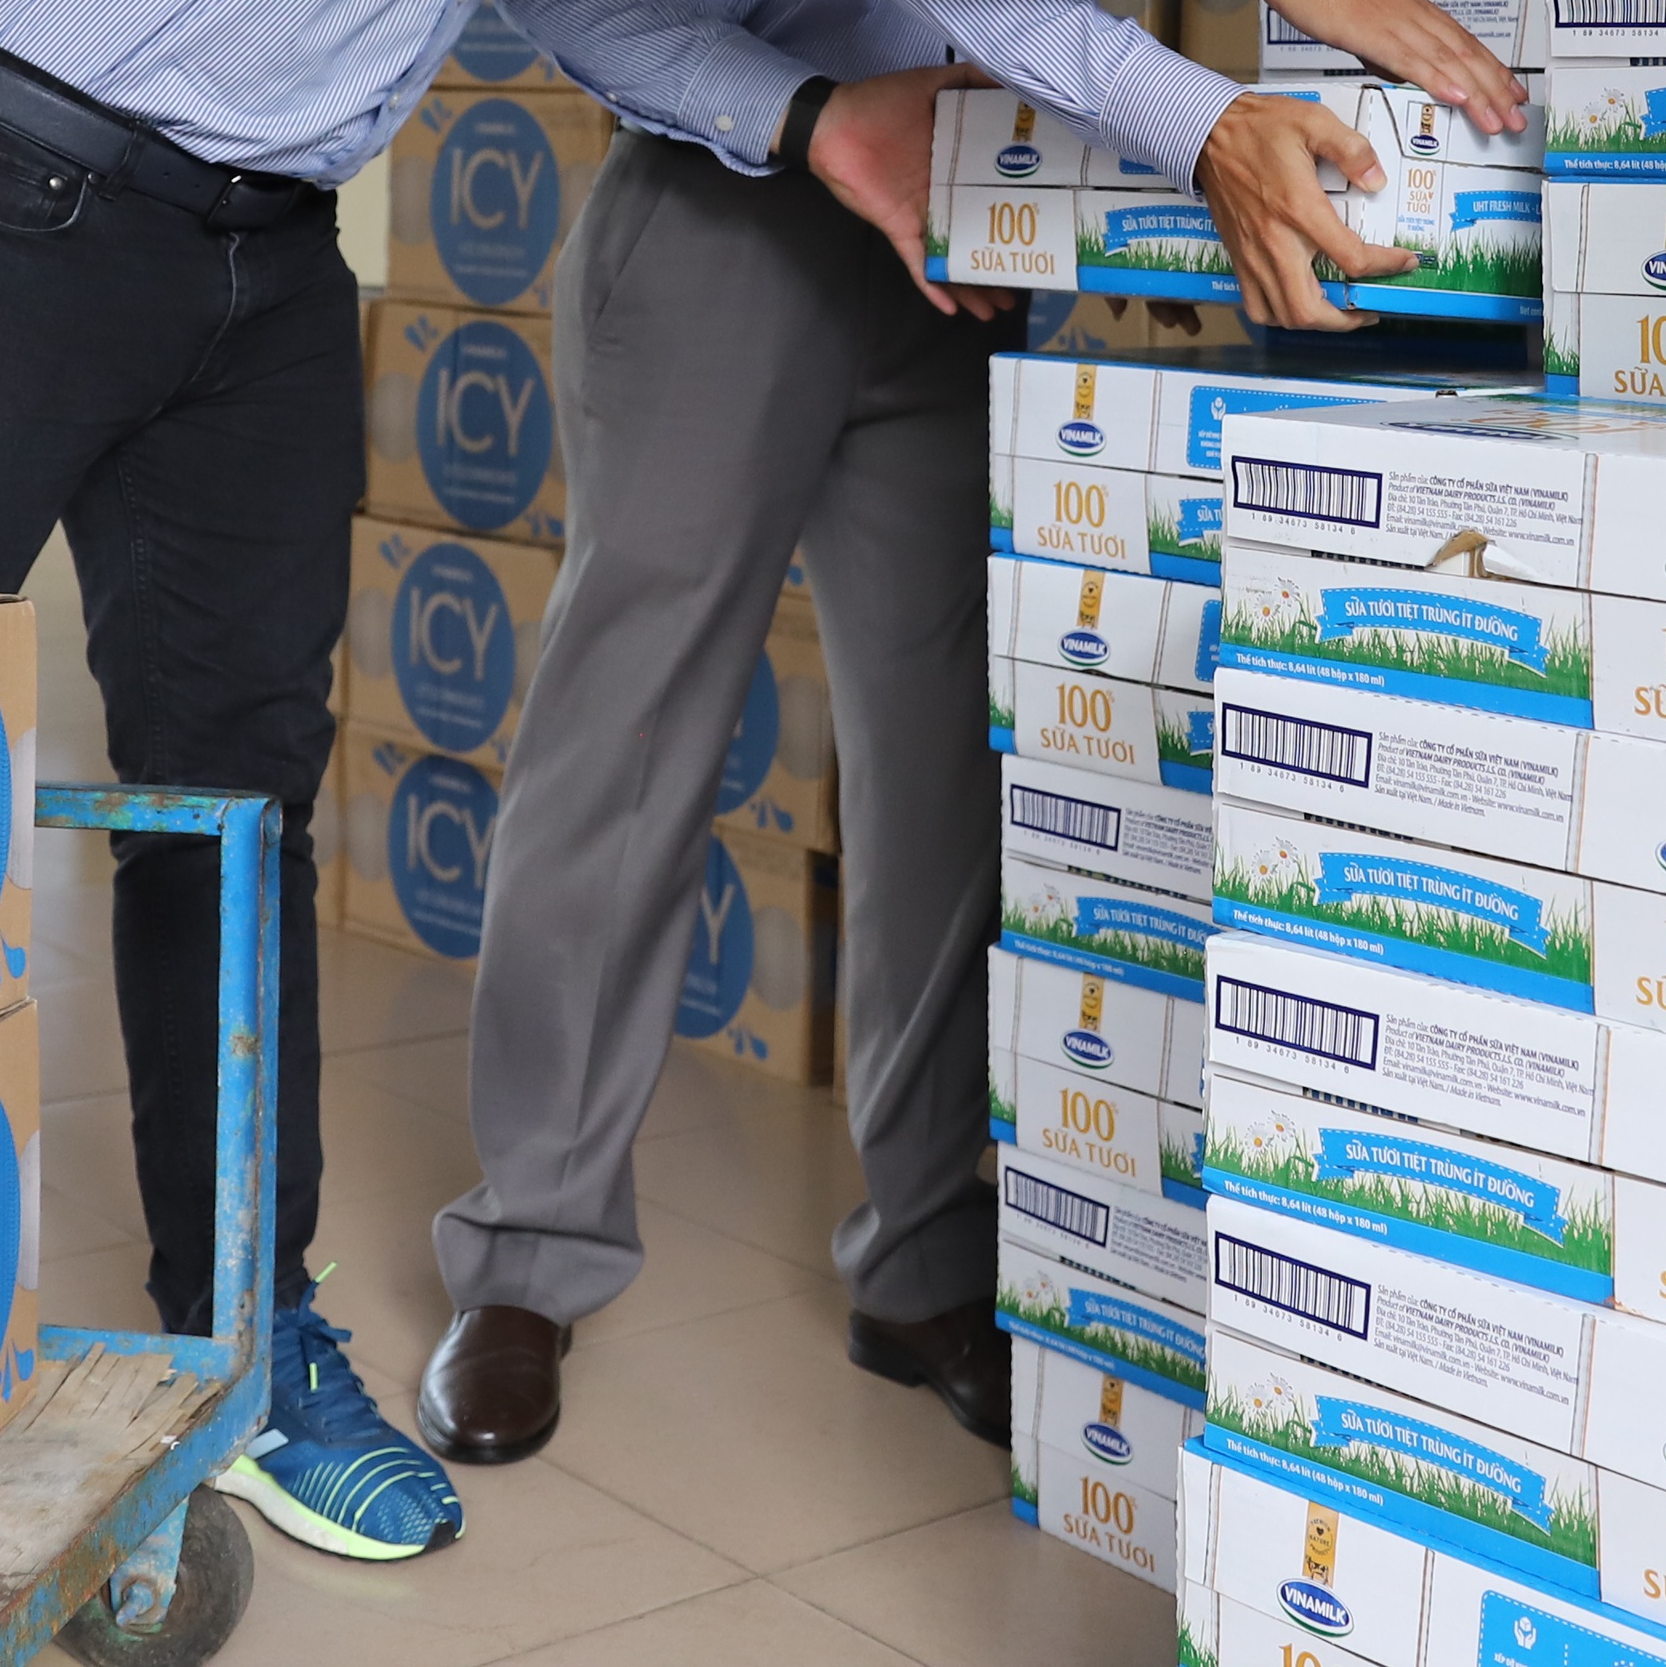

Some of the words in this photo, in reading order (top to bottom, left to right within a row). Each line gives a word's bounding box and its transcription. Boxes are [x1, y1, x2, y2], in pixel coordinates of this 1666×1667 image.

[1346, 1139, 1370, 1161] SỮA
[1371, 1145, 1400, 1167] TƯƠI
[1402, 1151, 1428, 1174] TIỆT
[1429, 1157, 1472, 1185] TRÙNG
[1473, 1167, 1486, 1189] ÍT
[1487, 1174, 1535, 1208] ĐƯỜNG
[1283, 1584, 1348, 1629] VINAMILK
